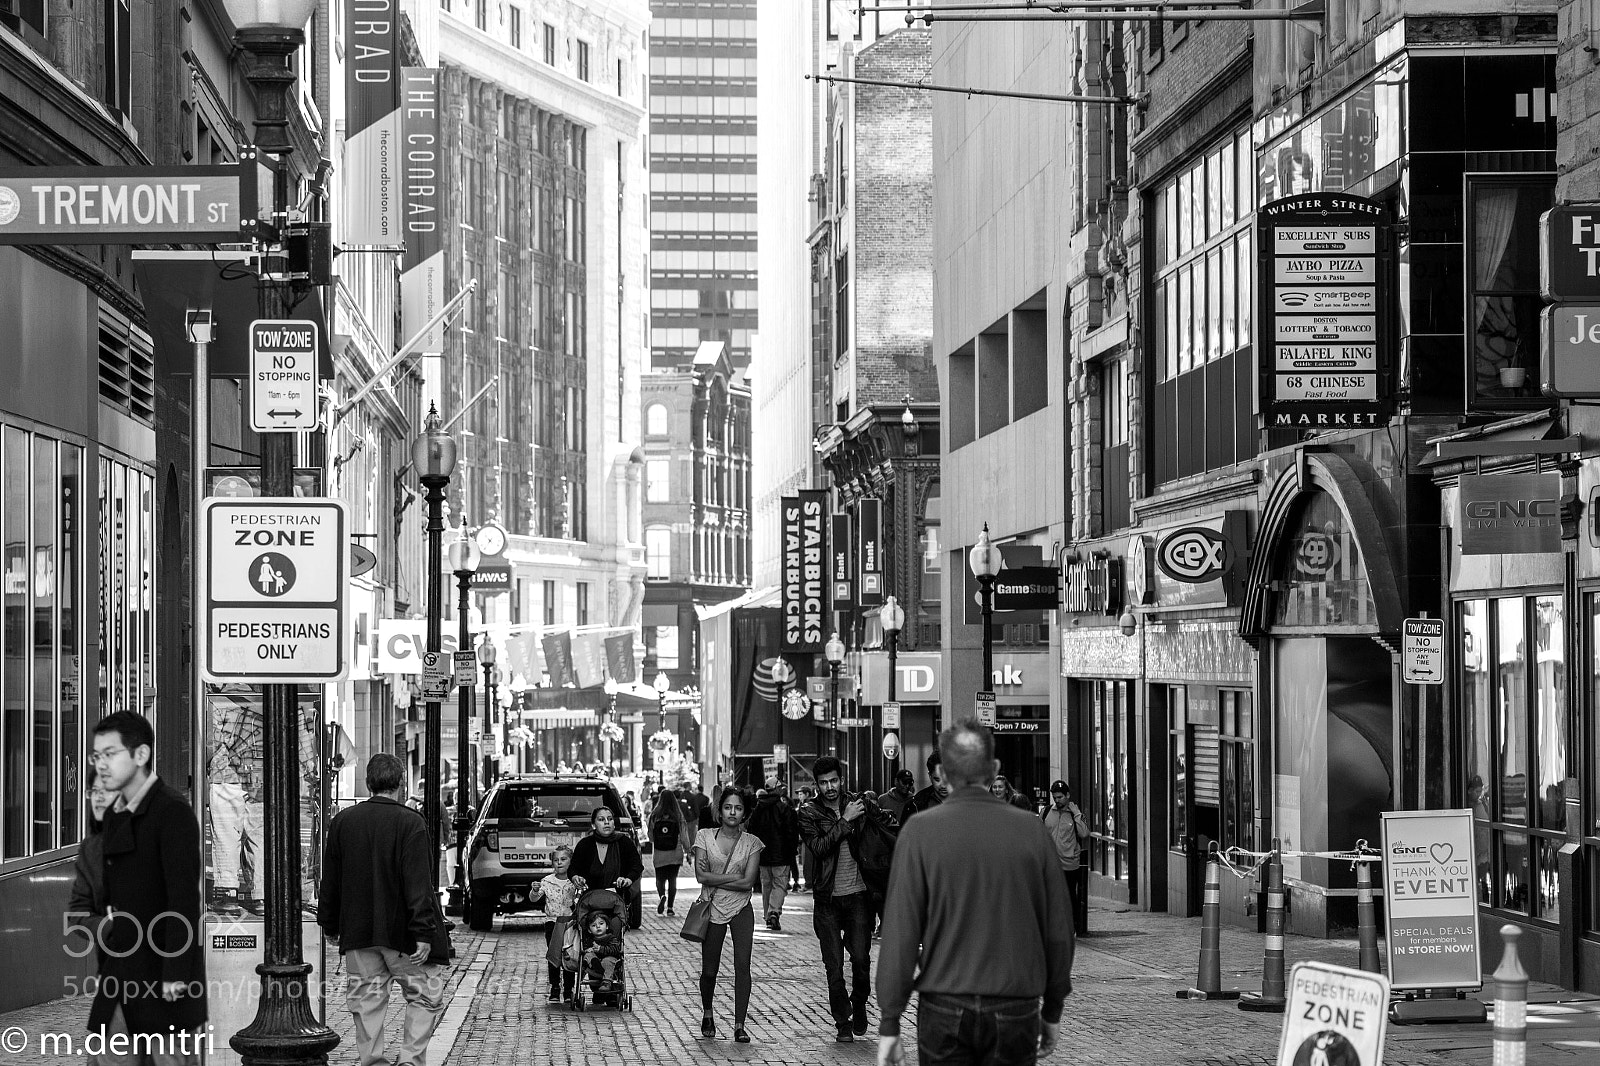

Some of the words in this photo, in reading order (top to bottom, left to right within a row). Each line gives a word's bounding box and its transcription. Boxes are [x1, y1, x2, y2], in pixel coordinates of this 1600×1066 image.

[408, 74, 435, 119] THE
[380, 130, 388, 236] theconradboston.com
[408, 134, 435, 233] CONRAD
[32, 184, 201, 225] TREMONT
[207, 202, 229, 224] ST
[1268, 200, 1322, 215] WINTER
[1331, 200, 1381, 215] STREET
[1278, 231, 1337, 241] EXCELLENT
[1343, 231, 1370, 240] SUBS
[1286, 260, 1322, 271] JAYBO
[1329, 260, 1363, 270] PIZZA
[1579, 247, 1600, 276] T
[1313, 291, 1371, 301] SmartBeep
[1280, 325, 1317, 333] LOTTERY
[257, 331, 281, 348] TOW
[283, 331, 312, 348] ZONE
[1280, 347, 1334, 359] FALAFEL
[1342, 347, 1372, 359] KING
[273, 355, 296, 369] NO
[258, 372, 311, 381] STOPPING
[1286, 376, 1303, 388] 68
[1310, 376, 1365, 388] CHINESE
[268, 390, 281, 399] 11am
[287, 390, 300, 400] 6pm
[1325, 390, 1348, 398] Food
[1276, 413, 1377, 424] MARKET
[1465, 498, 1556, 519] GNC
[231, 514, 321, 525] PEDESTRIAN
[234, 530, 315, 546] ZONE
[865, 541, 874, 571] Bank
[804, 501, 821, 644] STARBUCKS
[836, 552, 845, 580] Bank
[866, 575, 877, 592] TD
[997, 583, 1055, 594] GameStop
[837, 584, 847, 599] TD
[218, 623, 330, 639] PEDESTRIANS
[1407, 623, 1421, 634] TOW
[1422, 624, 1441, 634] ZONE
[1416, 638, 1430, 646] NO
[257, 644, 298, 660] ONLY
[896, 665, 934, 692] TD
[992, 664, 1023, 685] nk
[813, 683, 824, 691] TD
[994, 723, 1013, 731] Open
[1021, 723, 1039, 731] Days
[1393, 867, 1436, 877] THANK
[1441, 866, 1468, 876] YOU
[1393, 878, 1469, 895] EVENT
[1393, 928, 1436, 937] SPECIAL
[1439, 926, 1473, 935] DEALS
[1422, 936, 1457, 944] members
[1394, 946, 1406, 955] IN
[1408, 945, 1442, 954] STORE
[1444, 944, 1474, 953] NOW!
[1297, 978, 1379, 1006] PEDESTRIAN
[1303, 1001, 1366, 1030] ZONE
